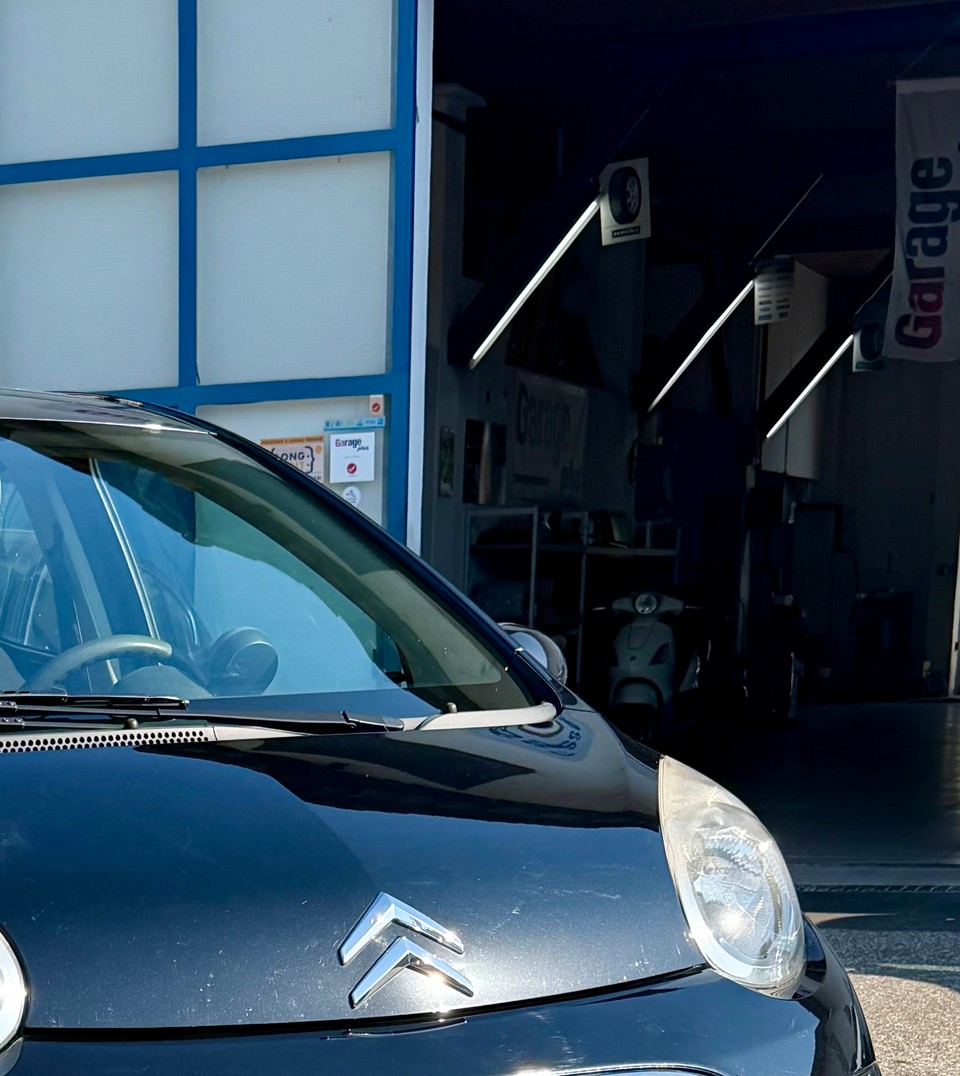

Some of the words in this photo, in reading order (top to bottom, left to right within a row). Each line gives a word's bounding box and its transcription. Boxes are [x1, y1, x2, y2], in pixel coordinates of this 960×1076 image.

[894, 156, 960, 349] Garage
[335, 438, 362, 449] Garage
[276, 452, 305, 461] ONG
